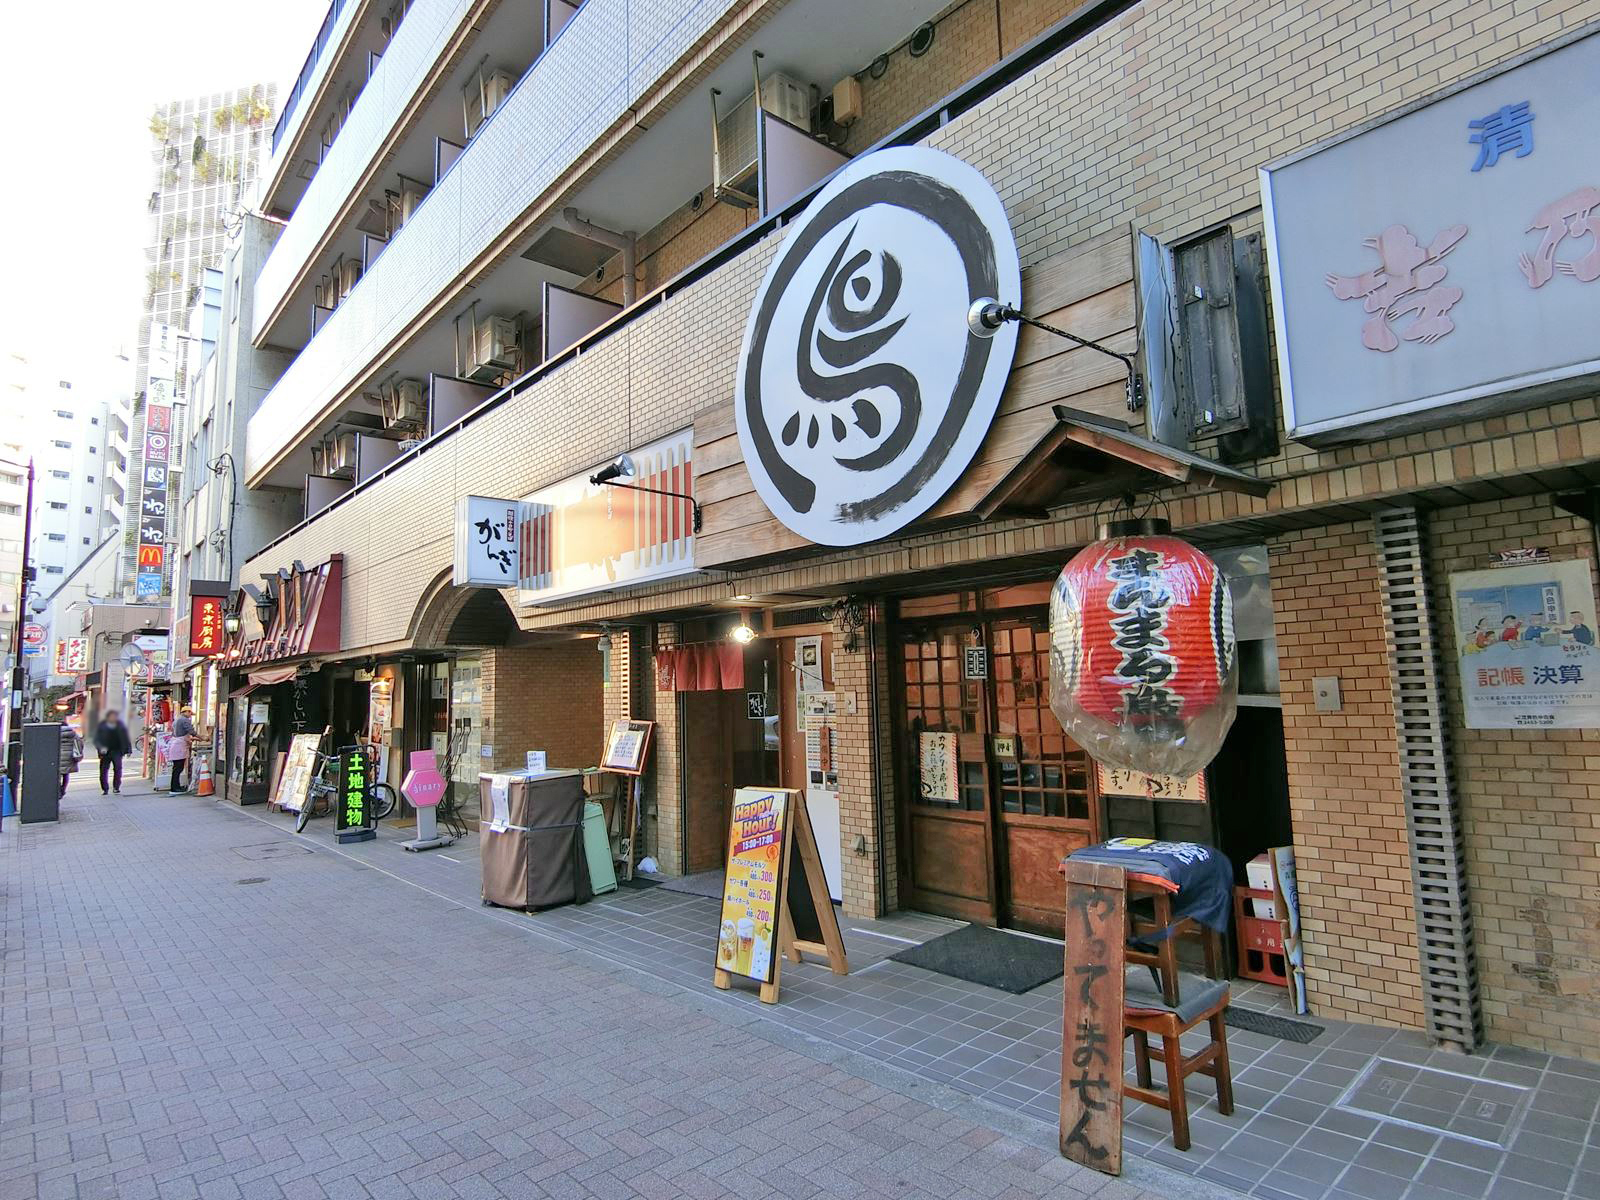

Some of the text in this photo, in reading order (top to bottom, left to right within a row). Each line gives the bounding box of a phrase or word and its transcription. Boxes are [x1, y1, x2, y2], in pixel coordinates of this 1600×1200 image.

[1468, 100, 1536, 172] 清
[474, 518, 517, 574] がんぎ
[1477, 664, 1584, 688] 記帳 決算
[346, 753, 364, 826] 土地建物
[735, 795, 775, 822] Happy
[742, 811, 780, 838] Hour!
[1064, 888, 1115, 1162] やってません
